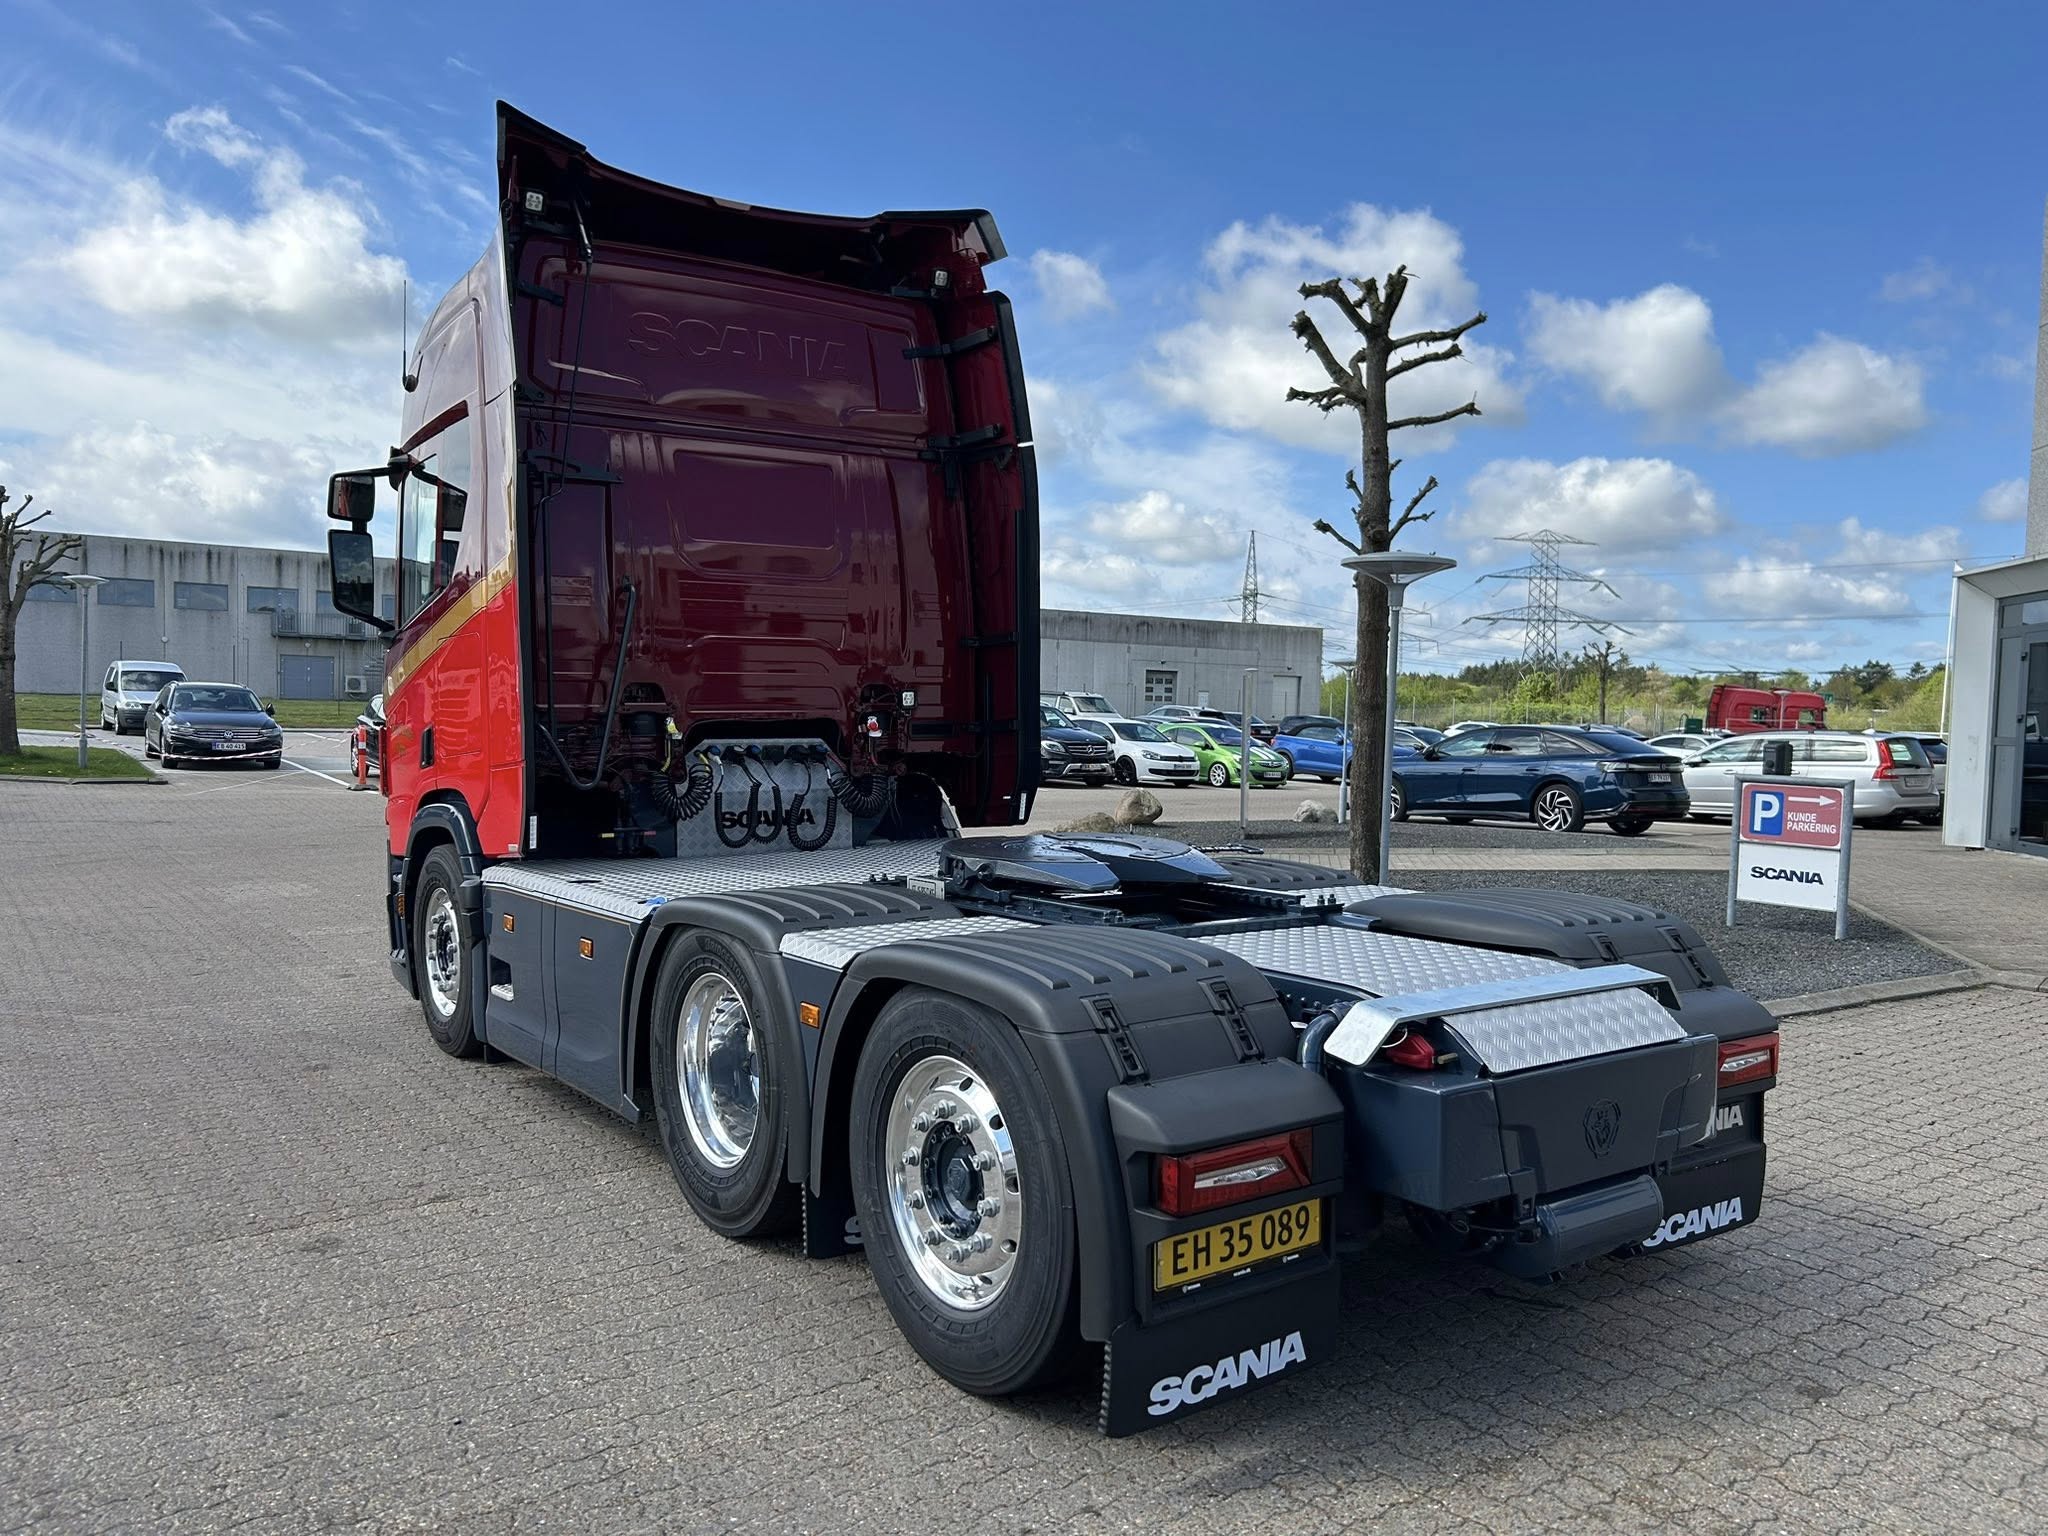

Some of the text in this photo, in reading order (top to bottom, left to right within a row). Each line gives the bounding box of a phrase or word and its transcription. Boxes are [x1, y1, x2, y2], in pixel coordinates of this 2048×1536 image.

[627, 311, 862, 386] SCANIA
[1753, 793, 1780, 831] P
[1786, 821, 1837, 834] PARKERING
[1787, 811, 1817, 822] KUNDE
[1750, 866, 1824, 885] SCANIA
[704, 937, 750, 990] BRIDGESTONE
[1172, 1205, 1310, 1276] EH 35 089
[1147, 1331, 1307, 1416] SCANIA
